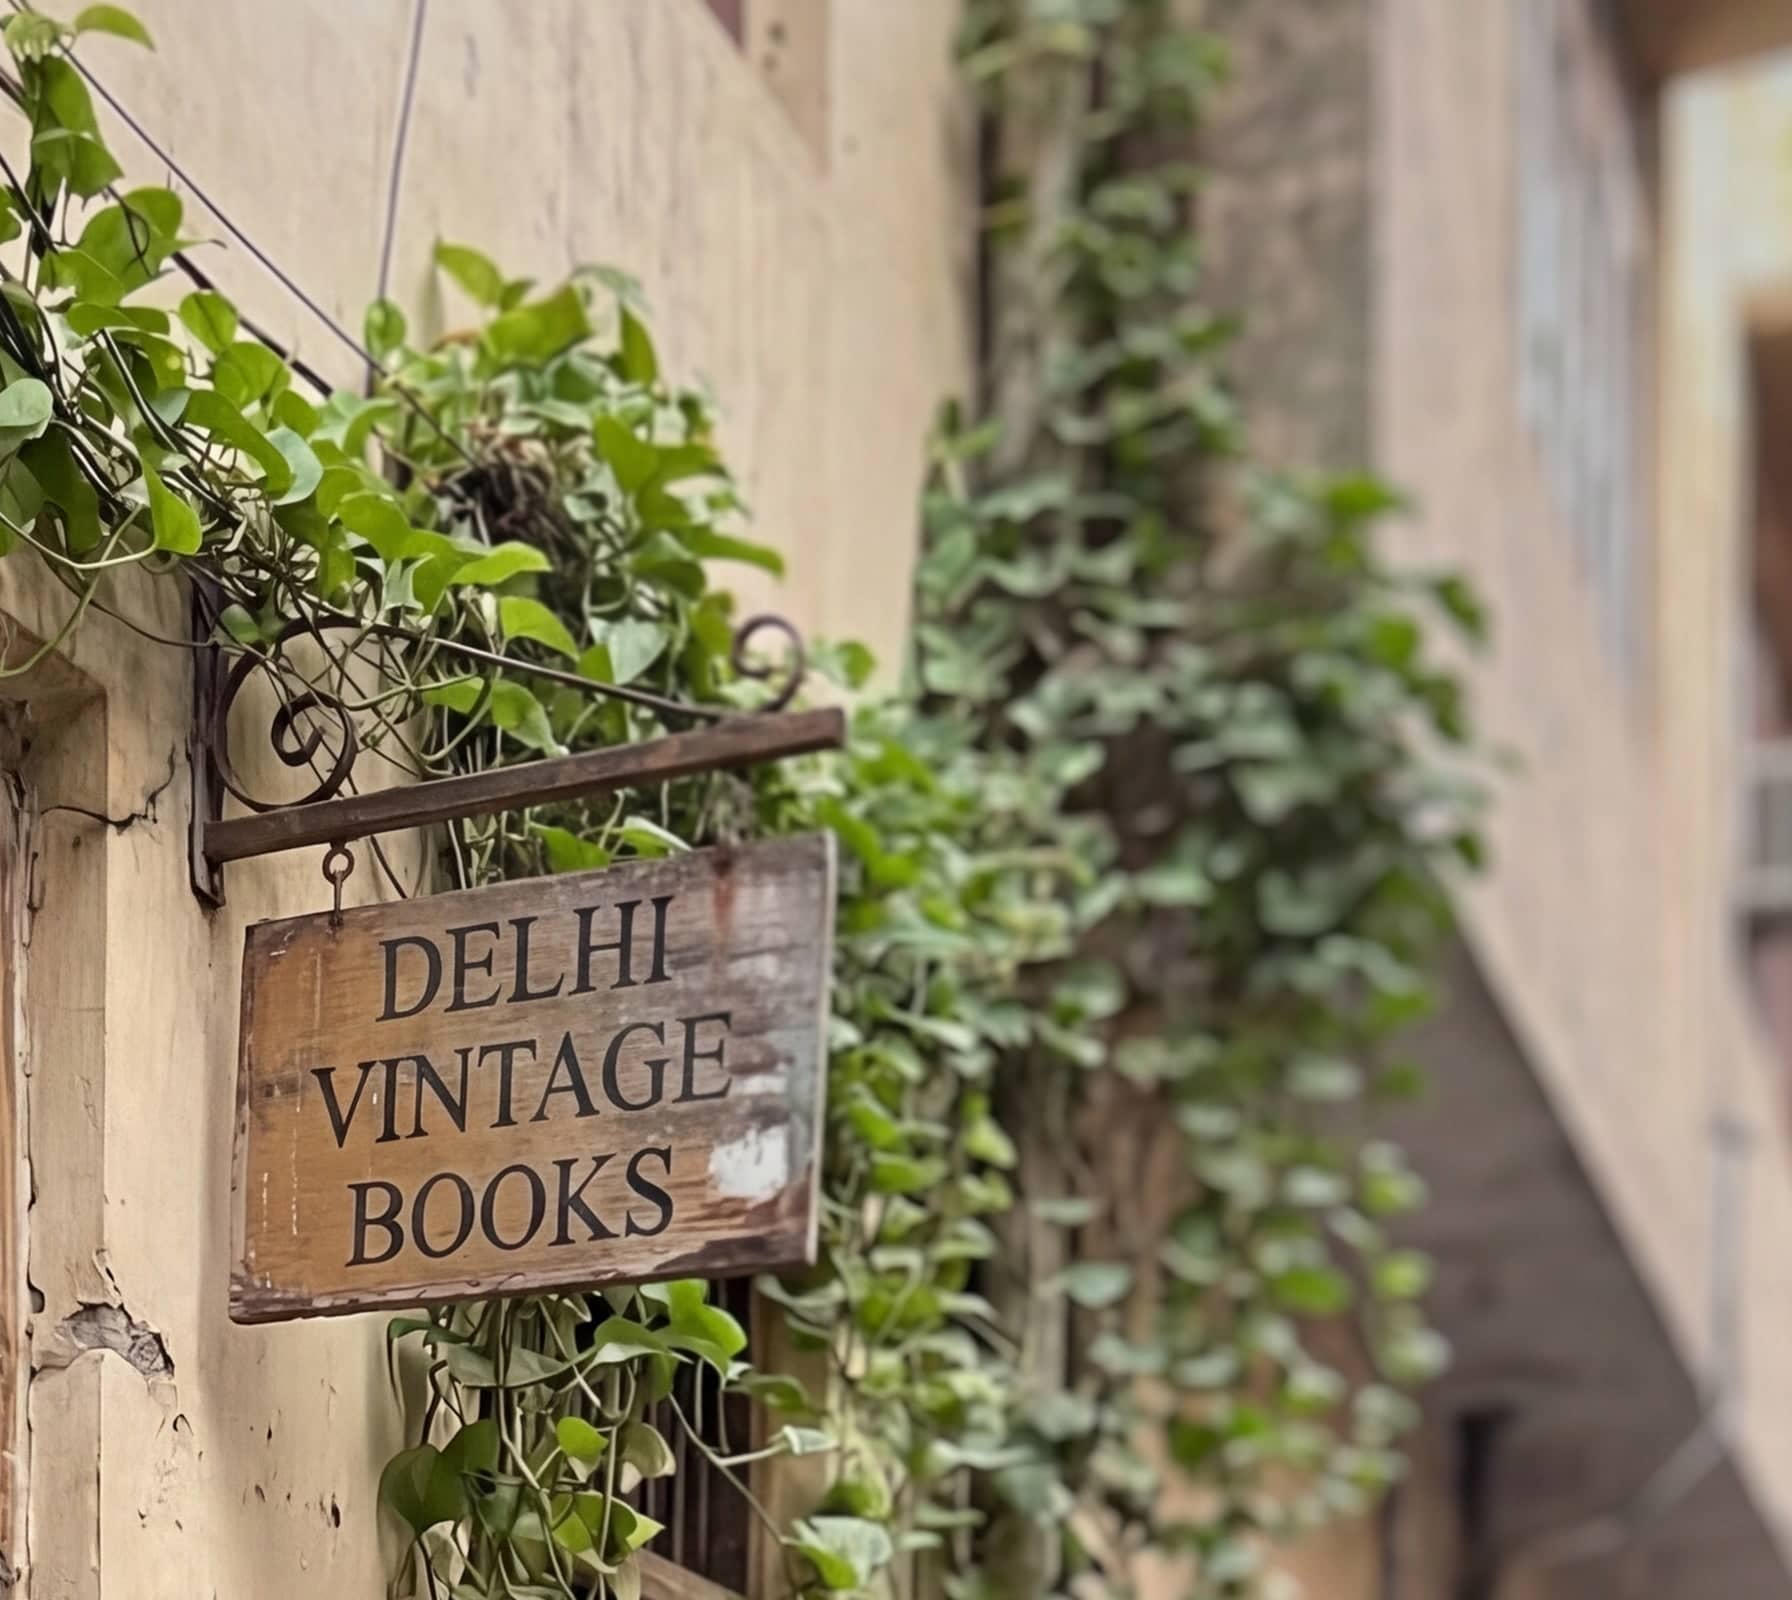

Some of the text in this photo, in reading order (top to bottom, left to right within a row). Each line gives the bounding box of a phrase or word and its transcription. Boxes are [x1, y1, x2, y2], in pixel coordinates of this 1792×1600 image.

[376, 895, 675, 1022] DELHI
[311, 1011, 734, 1148] VINTAGE
[345, 1145, 675, 1267] BOOKS
